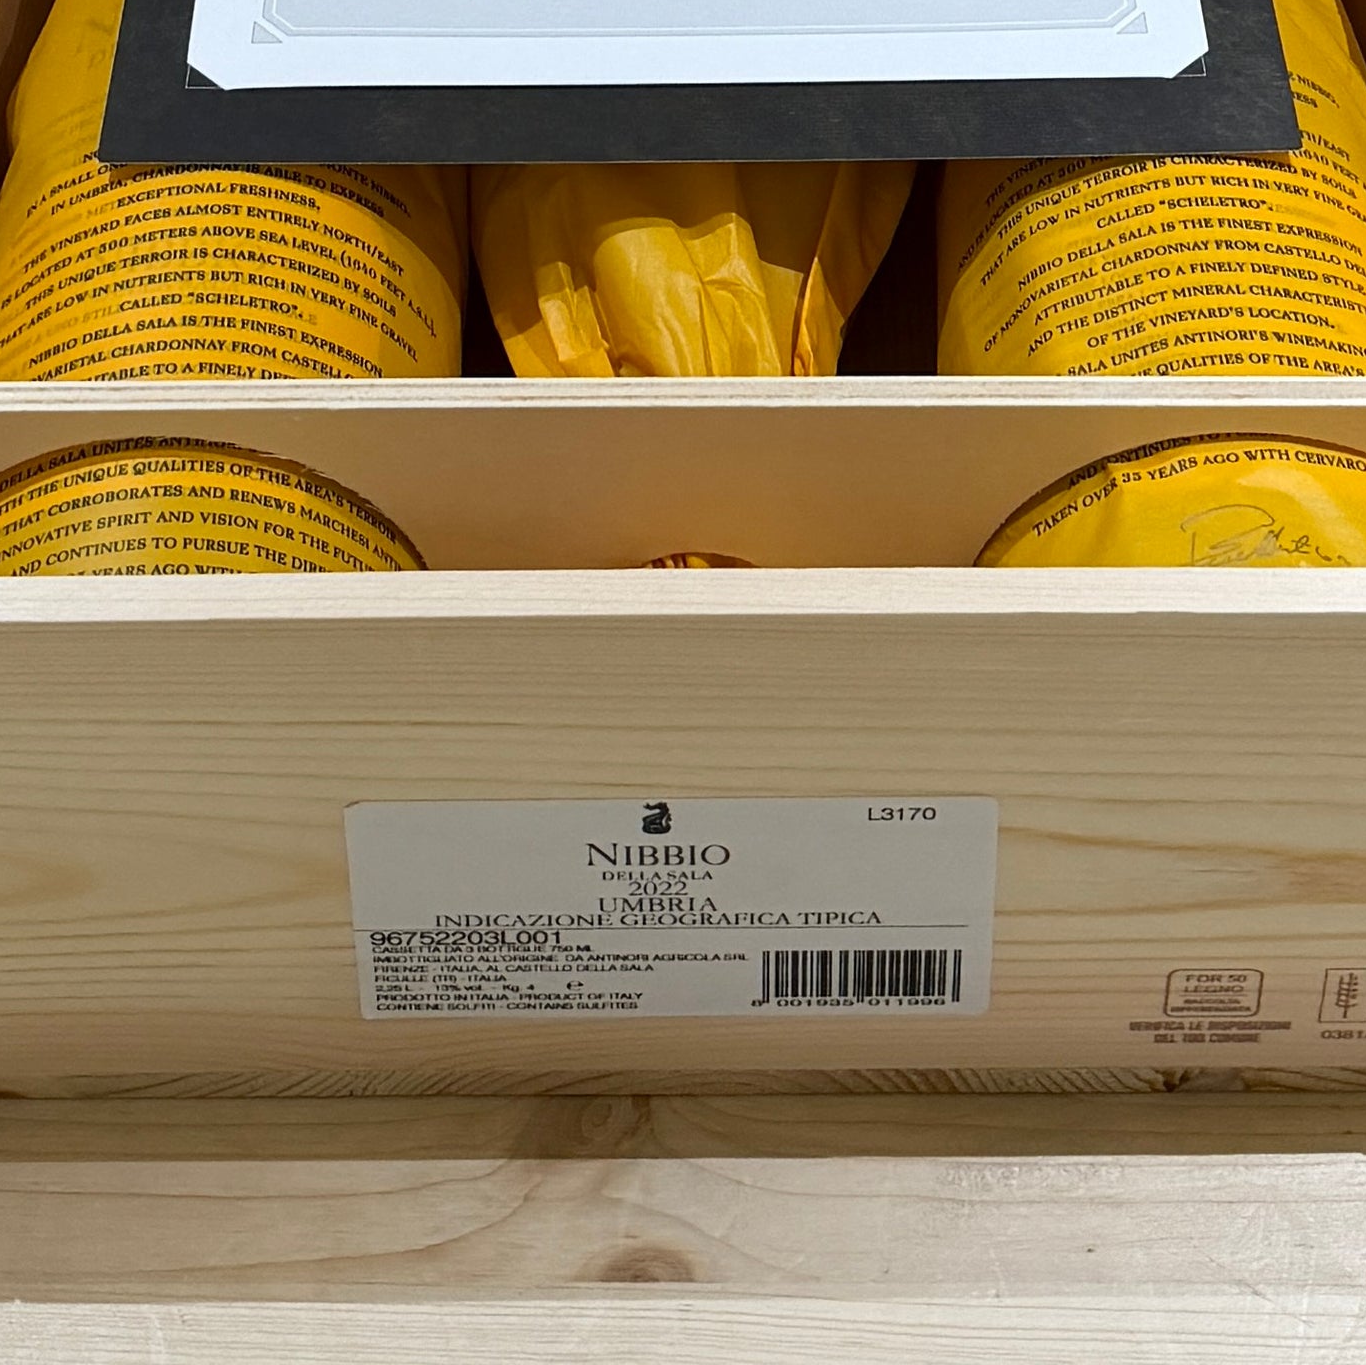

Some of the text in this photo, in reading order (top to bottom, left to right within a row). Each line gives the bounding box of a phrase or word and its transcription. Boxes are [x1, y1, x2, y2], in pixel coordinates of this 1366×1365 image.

[116, 182, 322, 211] EXCEPTIONAL FRESHNESS,
[49, 202, 405, 277] VINEYARD FACES ALMOST ENTIRELY NORTH/EAST
[134, 226, 197, 248] METERS
[201, 224, 254, 240] ABOVE
[258, 229, 288, 246] SEA
[291, 235, 337, 262] LEVEL
[1066, 237, 1115, 263] DELLA
[1117, 225, 1157, 246] SALA
[1160, 220, 1176, 232] IS
[1180, 218, 1215, 231] THE
[1217, 217, 1272, 233] FINEST
[1275, 222, 1366, 259] EXPRESSION
[1171, 284, 1247, 302] MINERAL
[118, 292, 183, 314] CALLED
[47, 484, 297, 518] CORROBORATES AND RENEWS
[1032, 502, 1079, 538] TAKEN
[1081, 475, 1118, 510] OVER
[1146, 456, 1198, 481] YEARS
[1203, 452, 1241, 467] AGO
[1243, 448, 1291, 463] WITH
[868, 807, 936, 821] L3170
[602, 871, 713, 880] DELLA SALA
[628, 881, 688, 896] 2022
[598, 897, 718, 912] UMBRIA
[436, 911, 882, 928] INDICAZIONE GEOGRAFICA TIPICA
[370, 932, 561, 945] 96752203L001
[470, 993, 508, 1001] ITALIA
[609, 992, 642, 1000] ITALY
